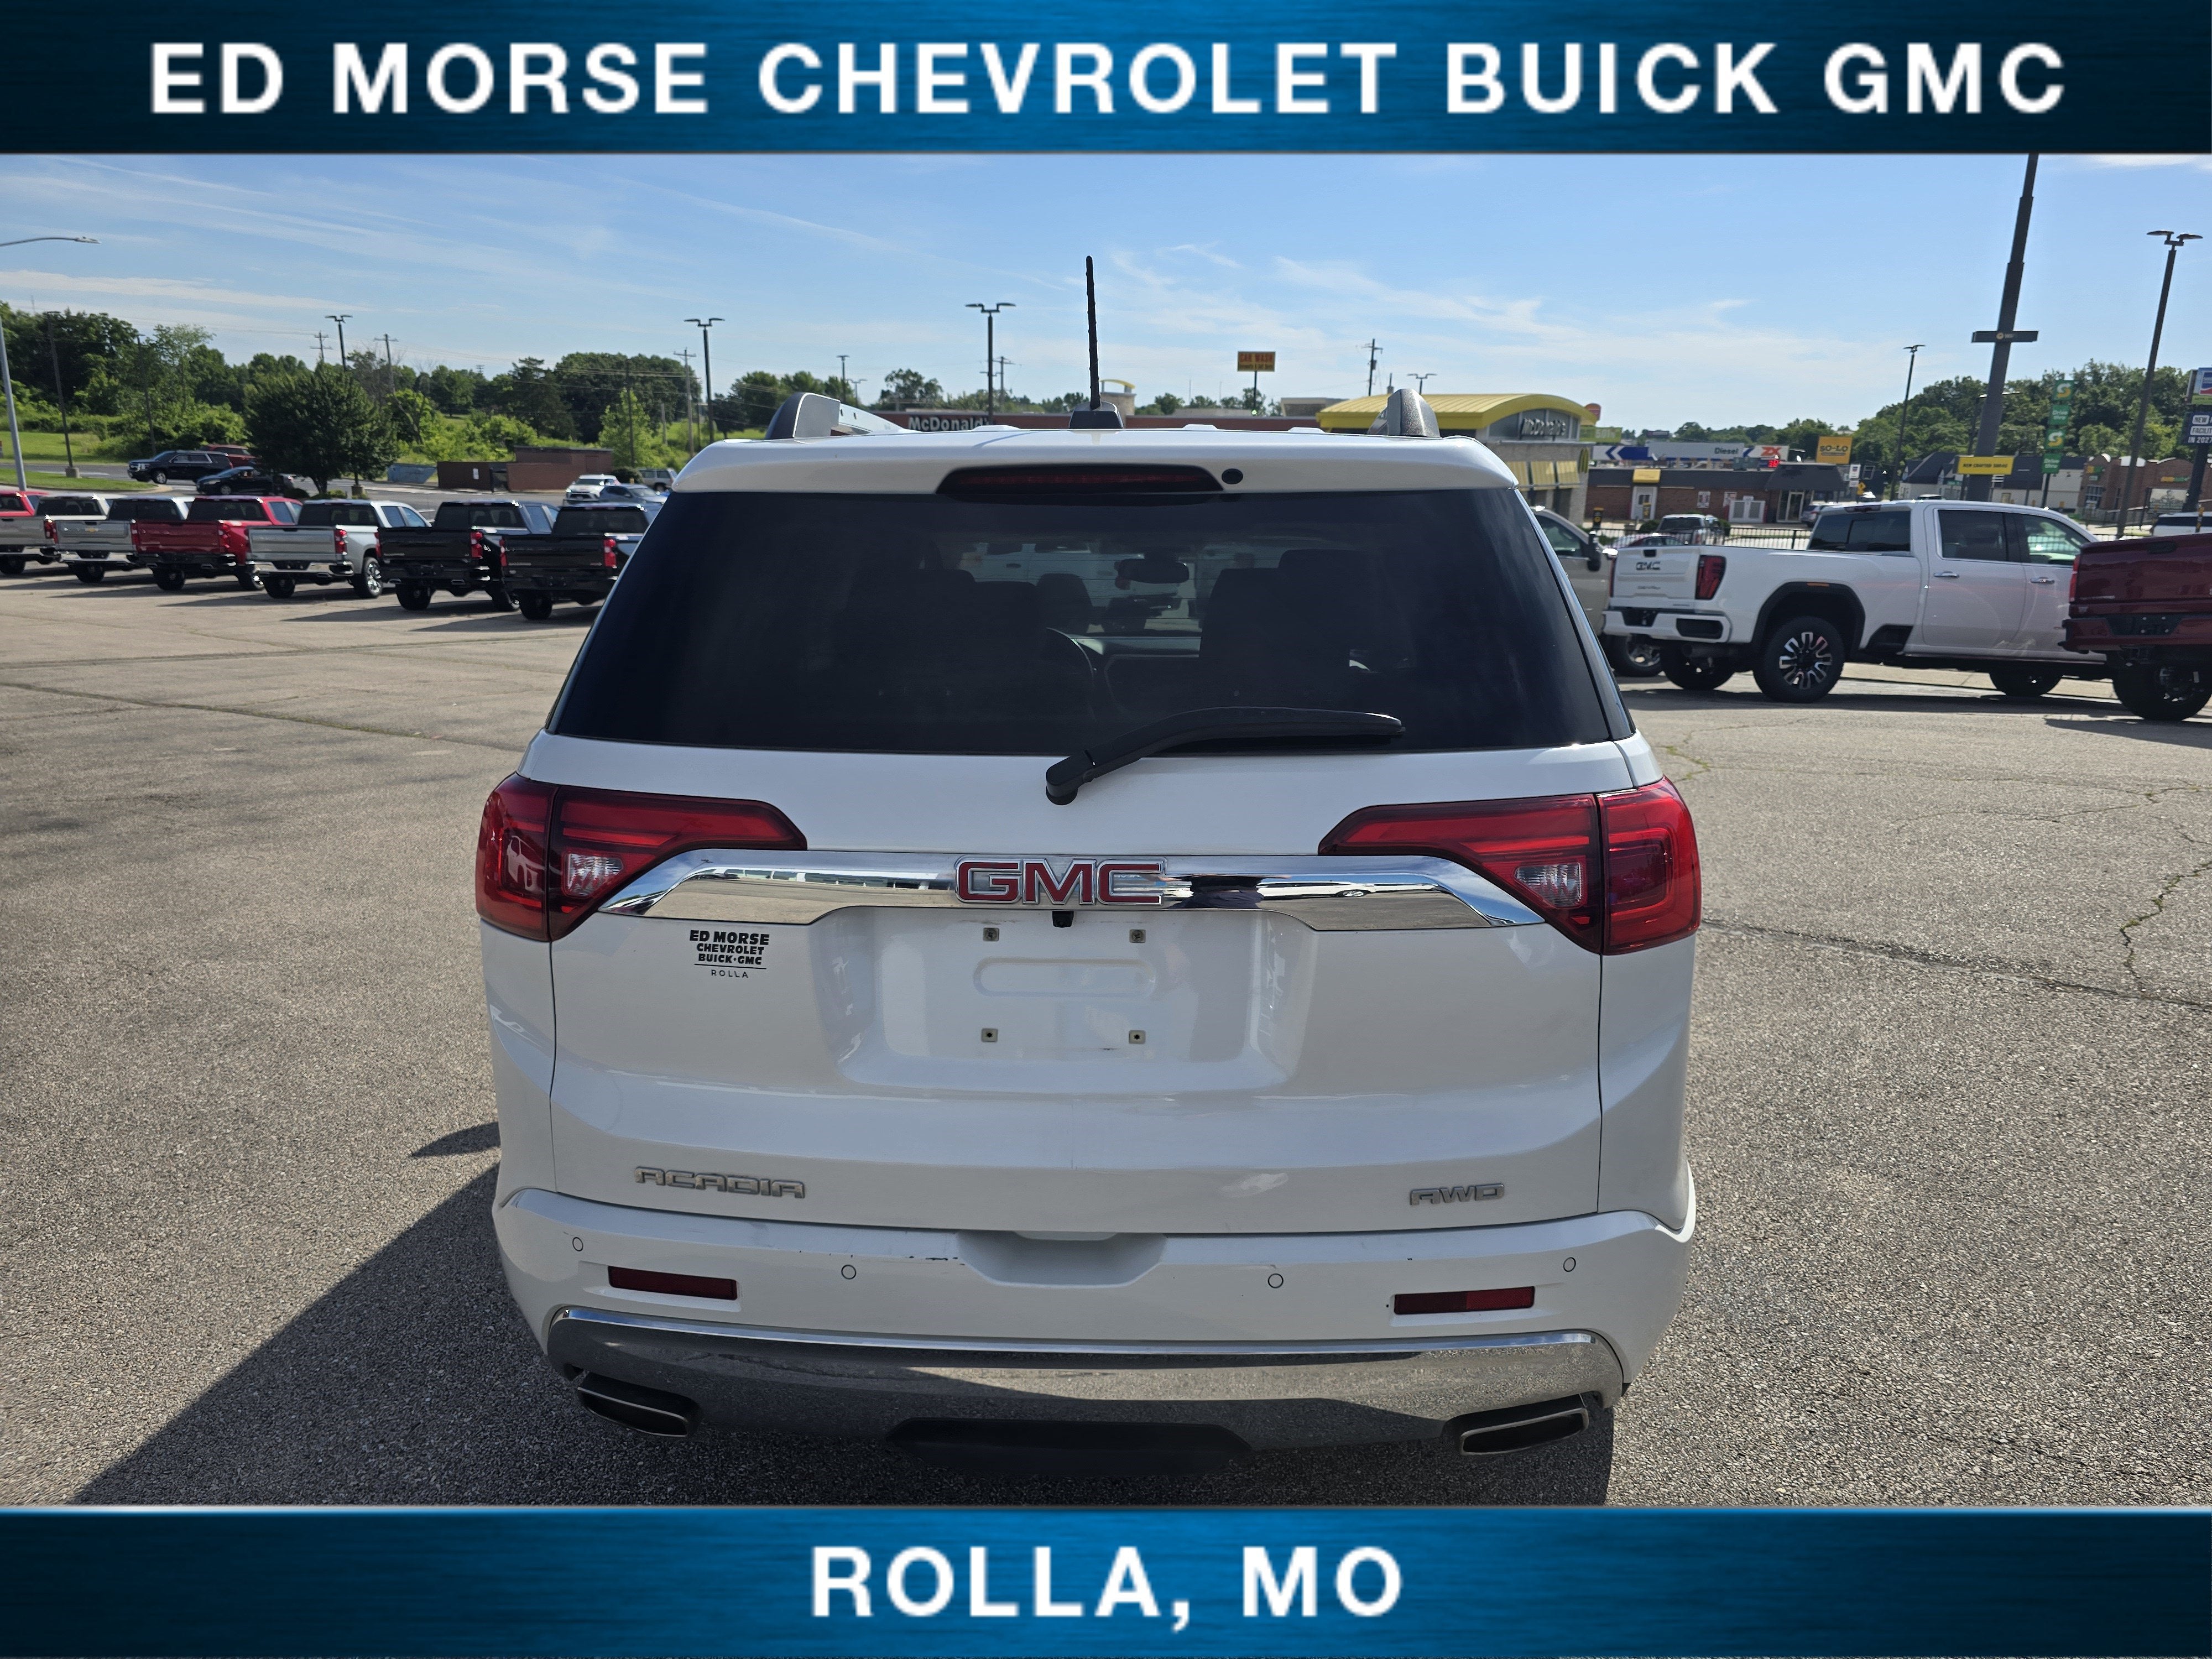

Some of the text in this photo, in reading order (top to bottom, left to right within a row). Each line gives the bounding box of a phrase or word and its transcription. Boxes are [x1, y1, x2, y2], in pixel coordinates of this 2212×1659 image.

[1636, 561, 1661, 570] GMC
[955, 857, 1163, 905] GMC
[690, 930, 769, 945] ED MORSE
[697, 943, 764, 955] CHEVROLET
[711, 969, 748, 978] ROLLA
[636, 1166, 805, 1198] ACADIA
[1410, 1183, 1505, 1206] AWD
